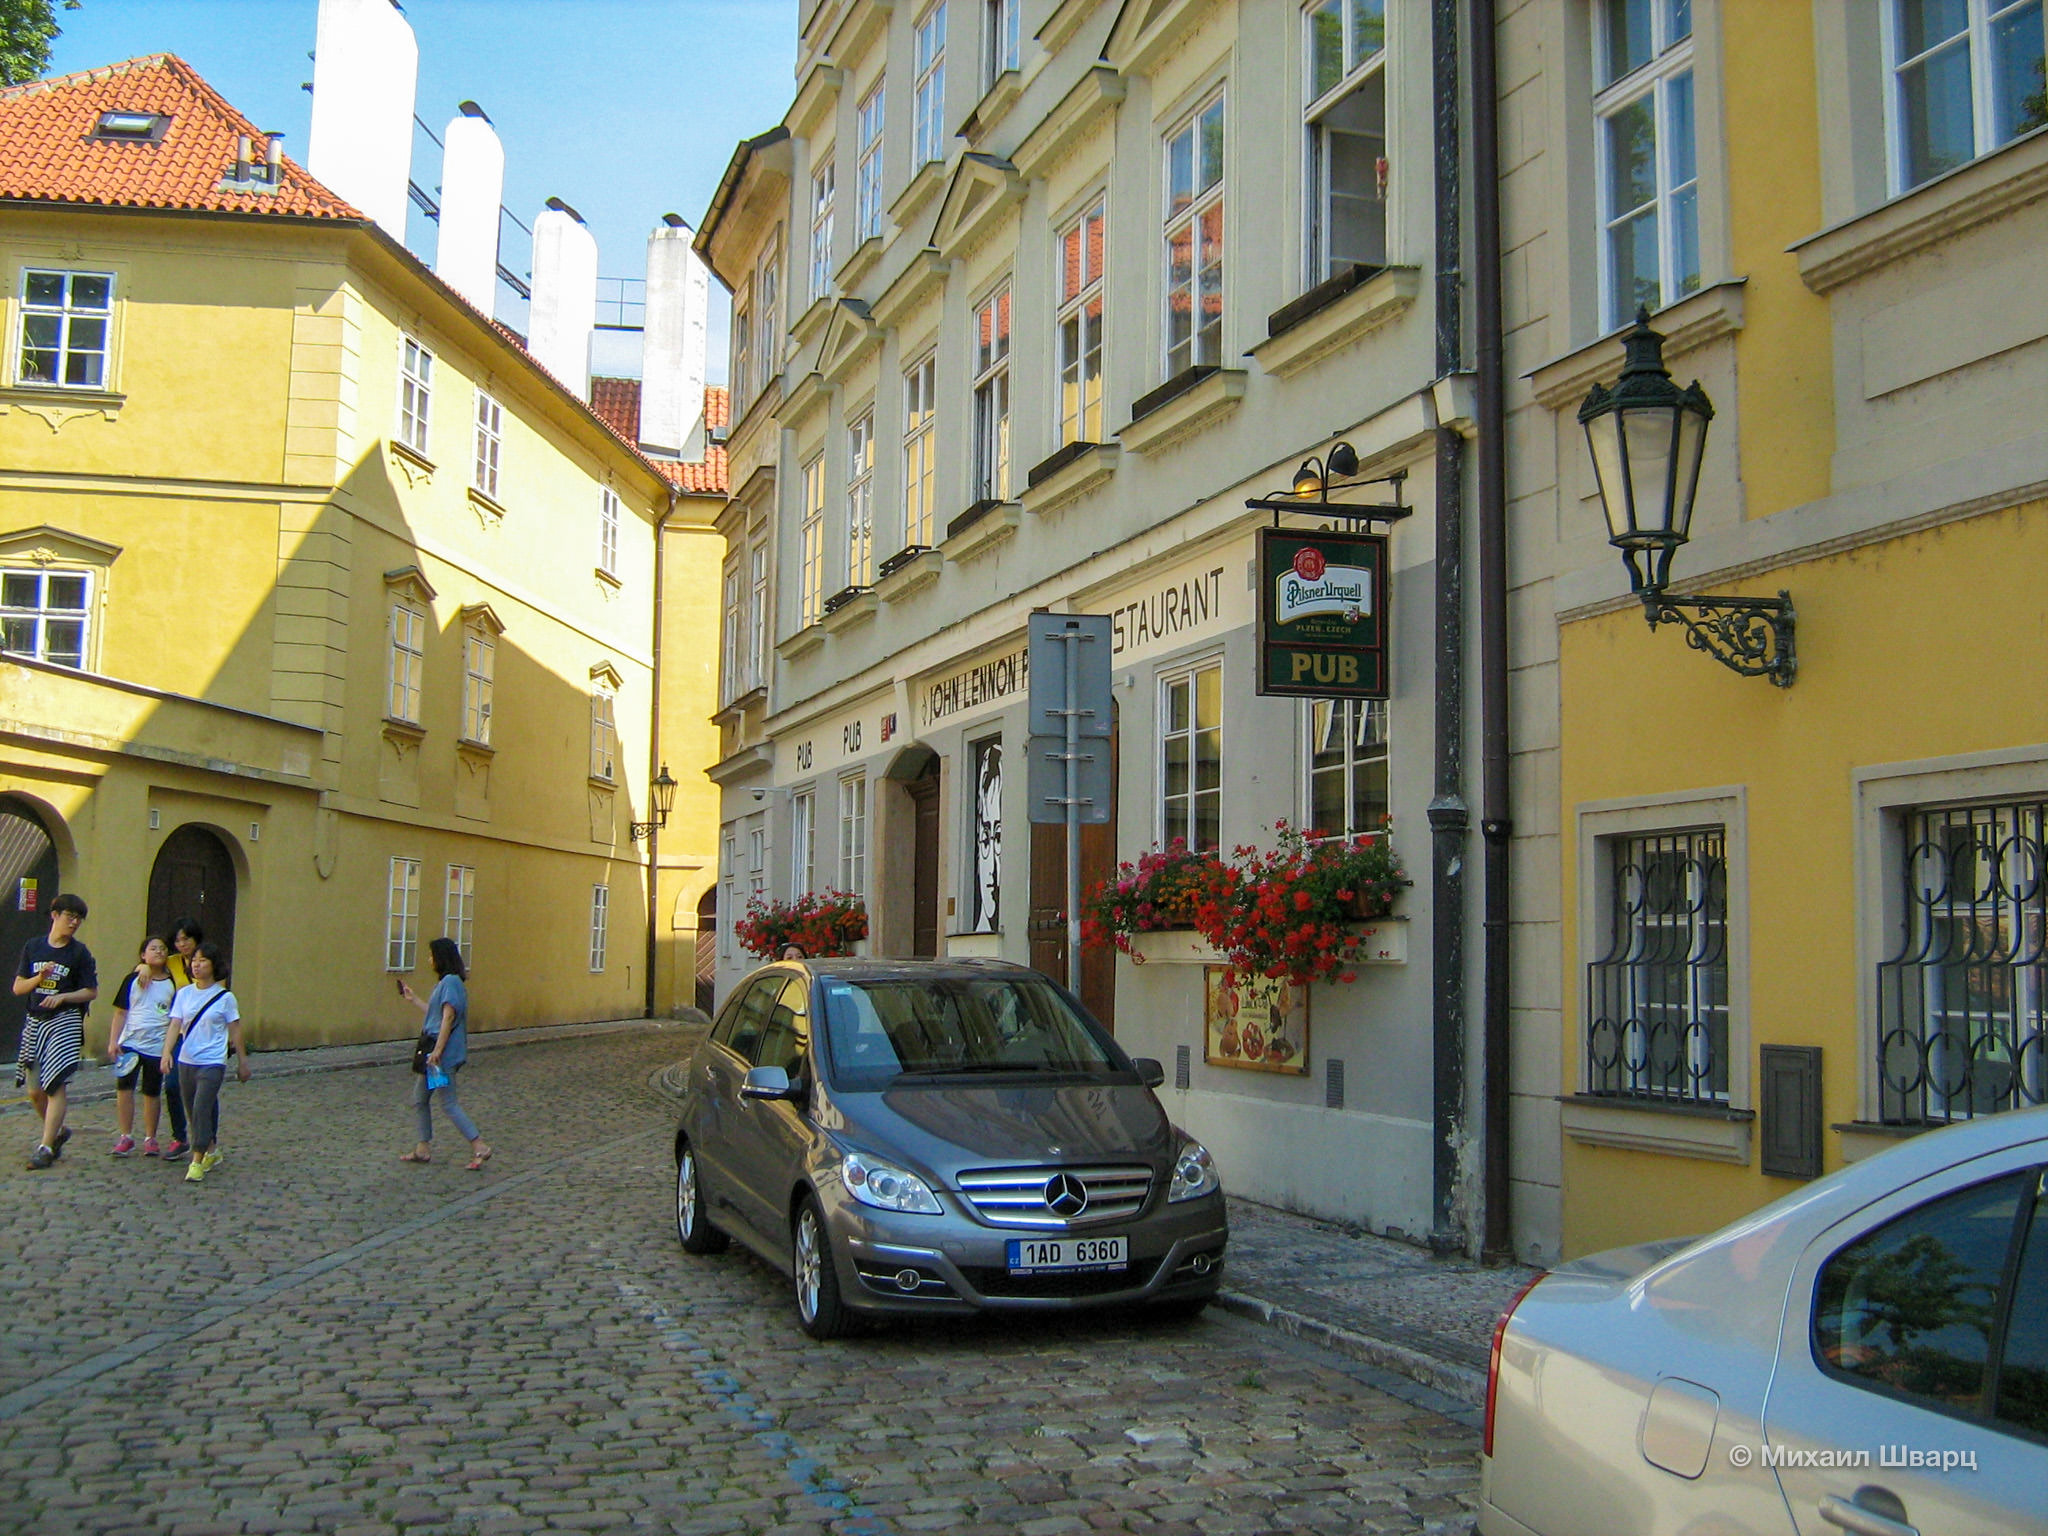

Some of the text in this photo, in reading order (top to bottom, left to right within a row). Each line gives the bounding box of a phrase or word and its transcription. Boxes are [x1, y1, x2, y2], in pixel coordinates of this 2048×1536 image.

[1286, 580, 1362, 609] Pilsner Urquell
[929, 676, 959, 726] JOHN
[964, 653, 1016, 709] LENNON
[1113, 567, 1224, 654] STAURANT
[1291, 652, 1359, 684] PUB
[843, 720, 862, 756] PUB
[797, 740, 812, 773] PUB
[1026, 1240, 1119, 1264] 1AD 6360
